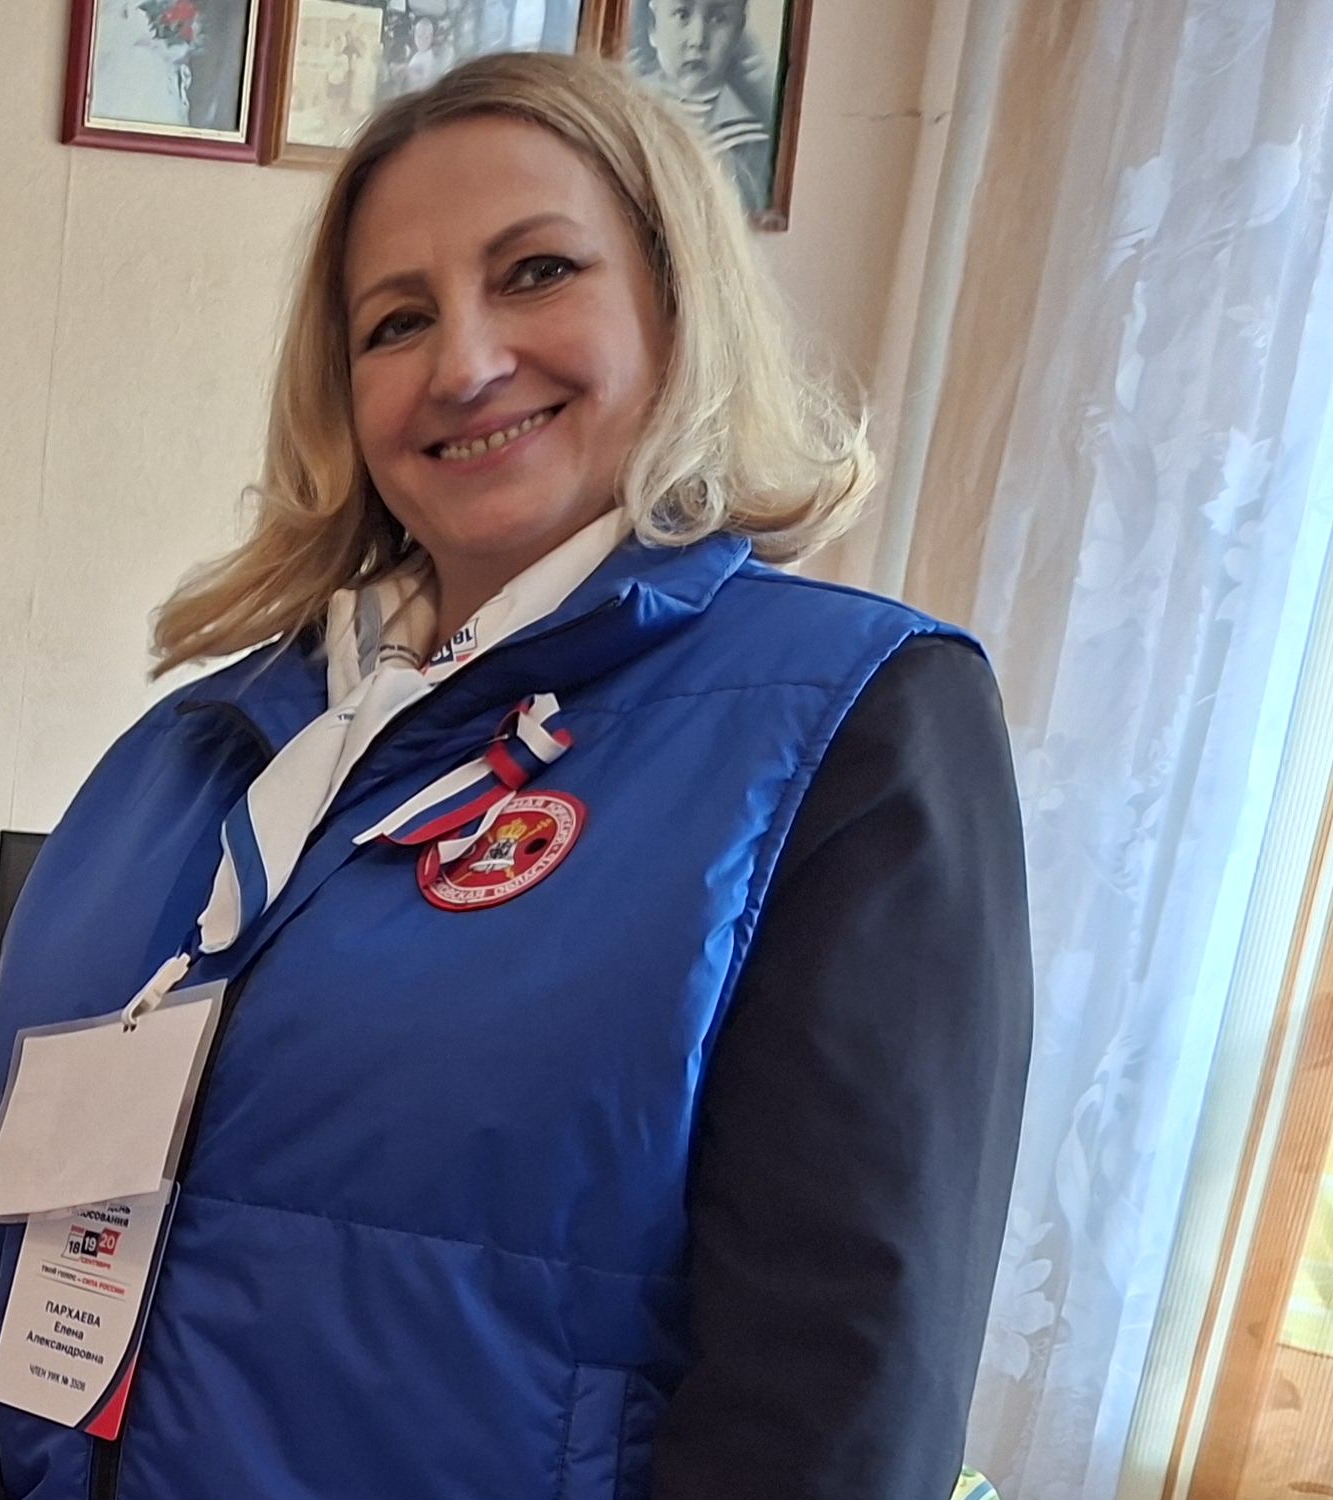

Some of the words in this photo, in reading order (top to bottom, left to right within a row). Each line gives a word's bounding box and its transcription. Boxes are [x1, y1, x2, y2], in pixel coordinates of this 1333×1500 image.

[69, 1240, 81, 1255] 18
[84, 1236, 97, 1252] 19
[99, 1233, 115, 1250] 20
[45, 1300, 101, 1328] ПАРХАЕВА
[54, 1320, 84, 1341] Елена
[26, 1330, 104, 1365] Александровна
